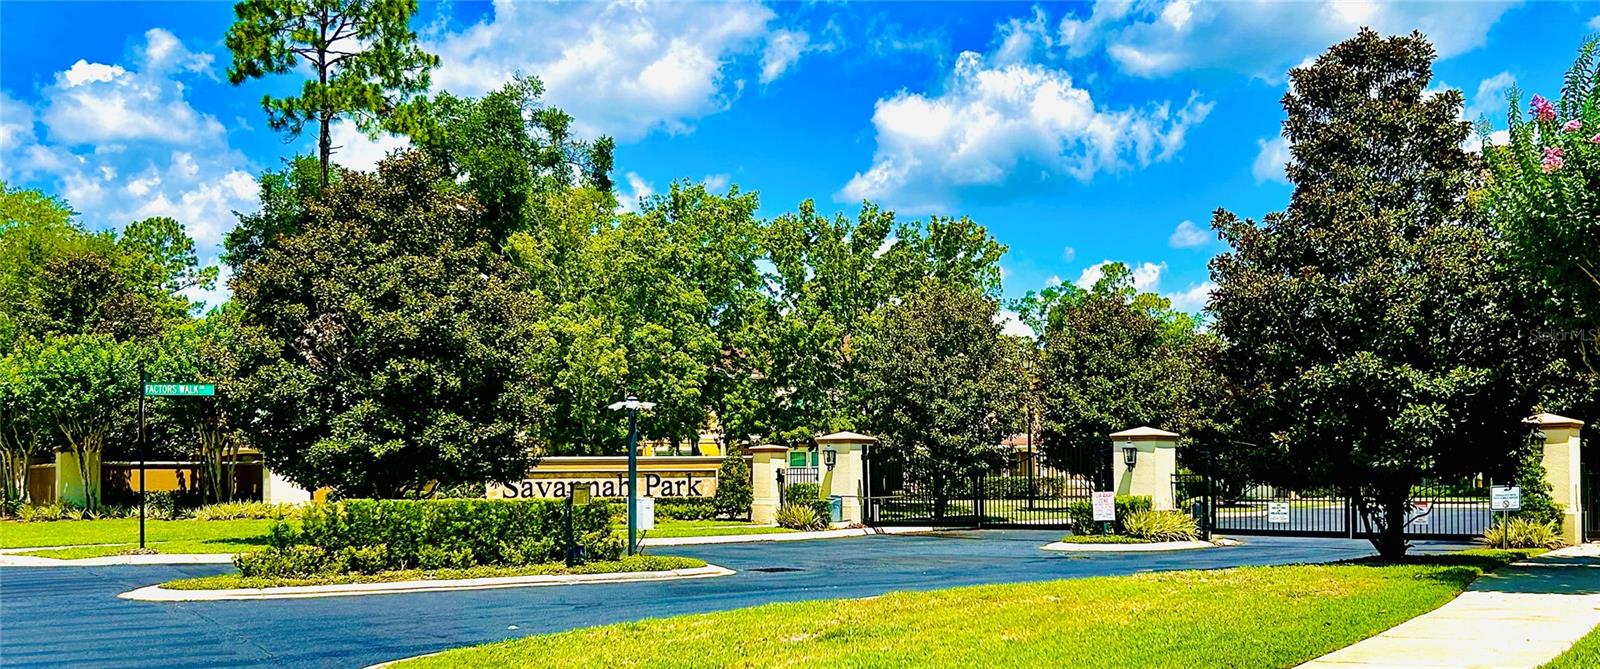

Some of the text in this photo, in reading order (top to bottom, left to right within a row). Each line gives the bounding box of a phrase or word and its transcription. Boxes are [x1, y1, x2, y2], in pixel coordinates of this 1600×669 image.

[145, 384, 177, 394] FACTORS
[179, 384, 199, 394] WALK
[643, 473, 703, 498] Park
